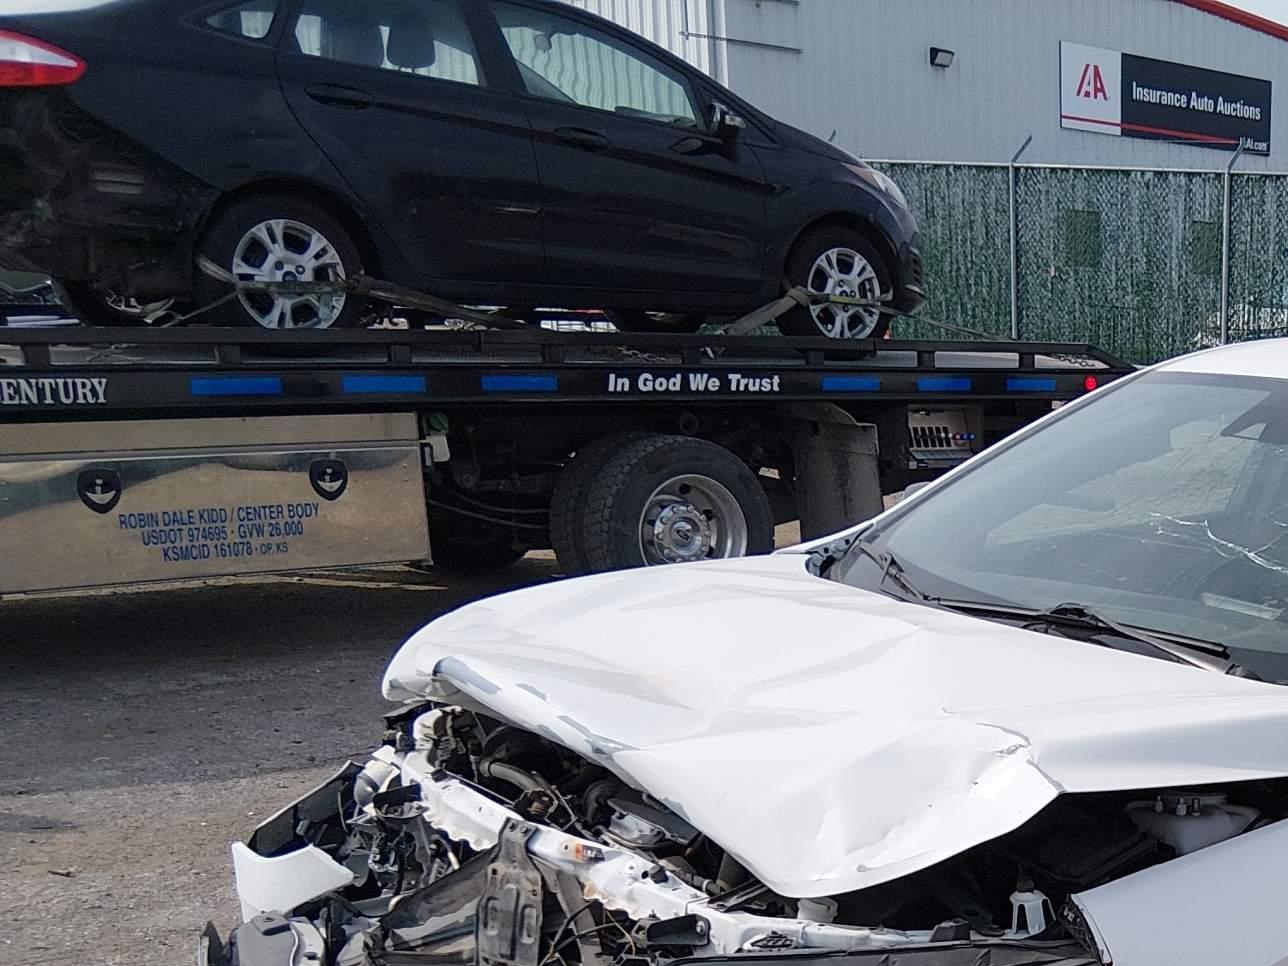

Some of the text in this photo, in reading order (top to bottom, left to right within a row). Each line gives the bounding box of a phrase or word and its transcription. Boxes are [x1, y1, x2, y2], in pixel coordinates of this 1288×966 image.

[1132, 81, 1261, 121] Insurance Auto Auctions
[607, 373, 781, 392] In God We Trust
[118, 512, 160, 529] ROBIN
[161, 509, 196, 527] DALE
[198, 508, 228, 525] KIDD
[237, 504, 285, 522] CENTER
[287, 502, 319, 519] BODY
[141, 528, 184, 546] USDOT
[187, 525, 228, 543] 974695
[238, 522, 265, 539] GVW
[162, 543, 210, 562] KSMCID
[213, 540, 253, 559] 161078
